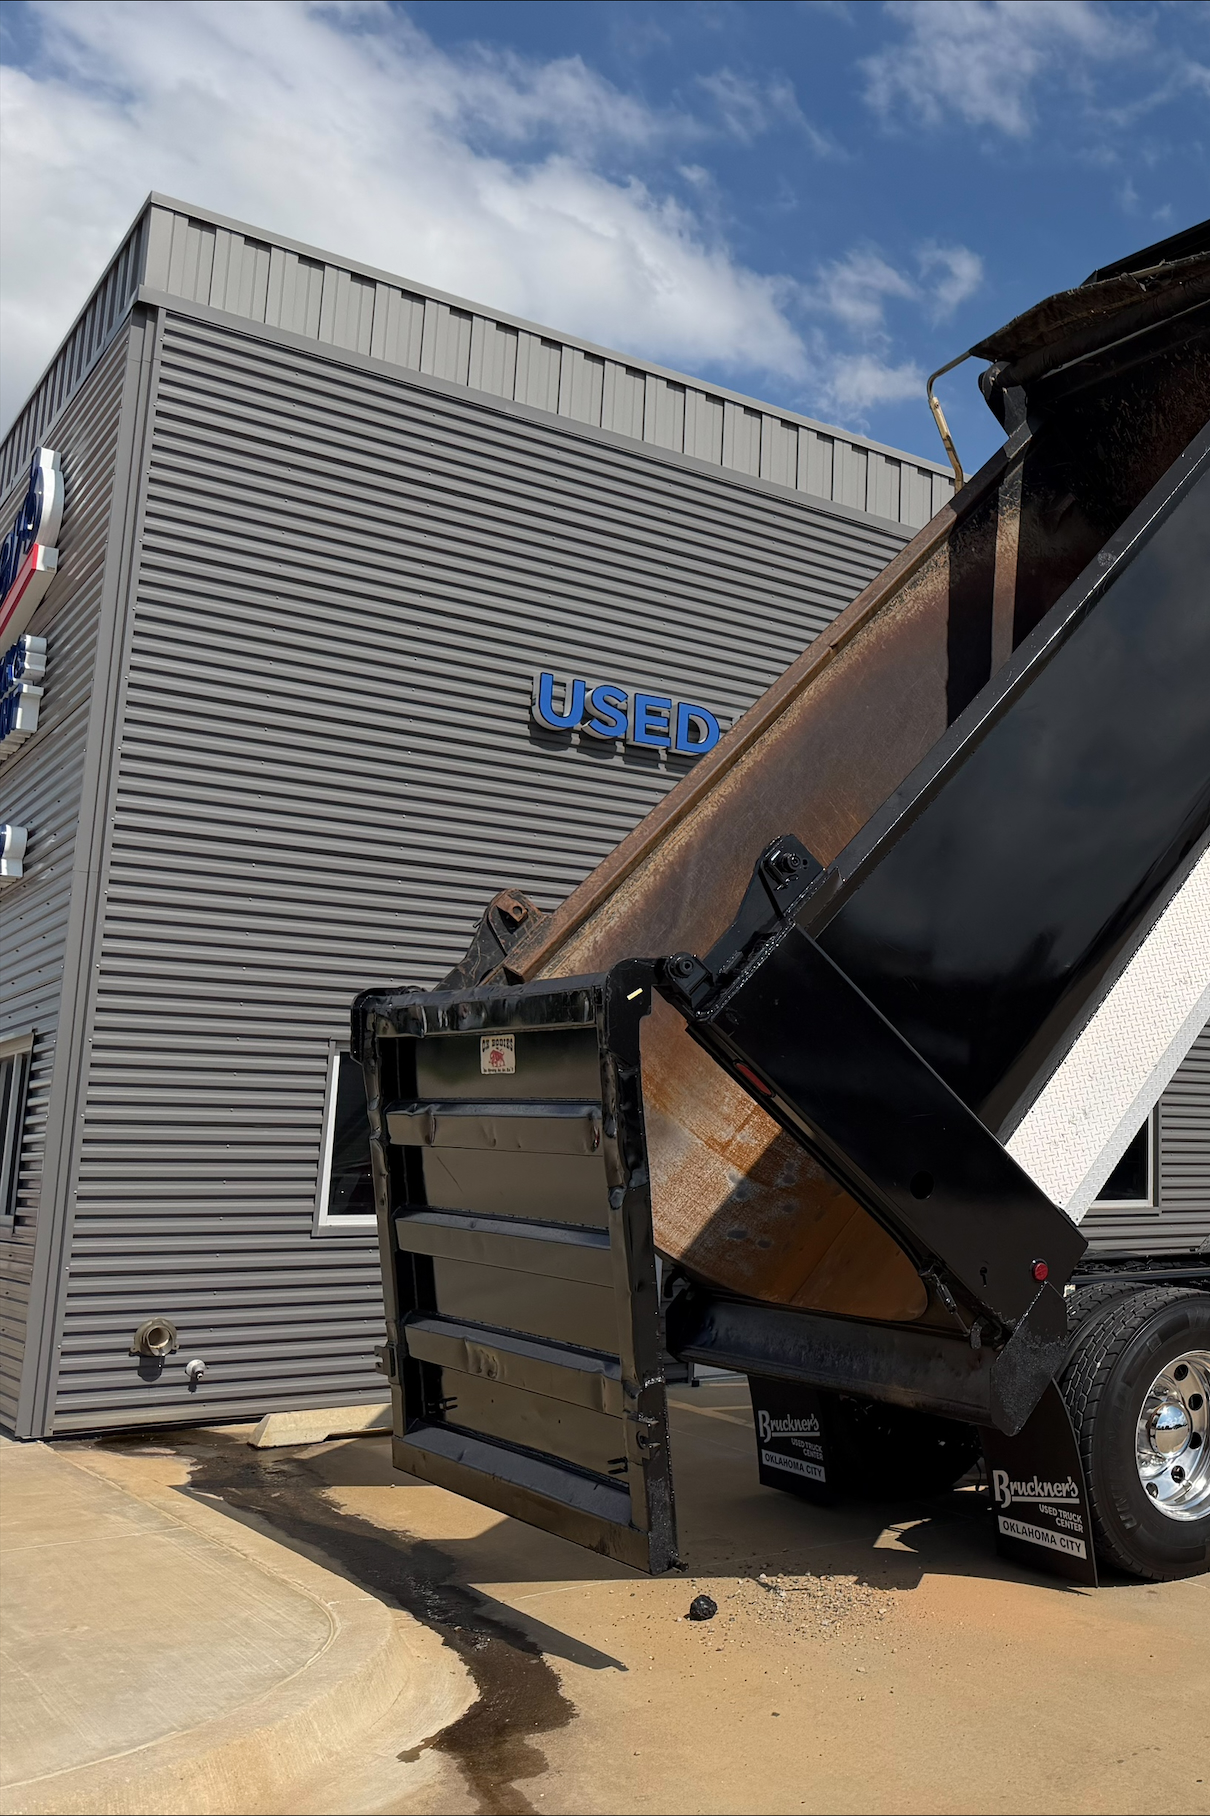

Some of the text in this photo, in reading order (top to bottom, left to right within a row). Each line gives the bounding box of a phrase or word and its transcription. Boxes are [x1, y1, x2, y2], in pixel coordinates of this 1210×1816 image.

[534, 672, 721, 755] USED
[758, 1410, 820, 1443] Bruckner's
[791, 1438, 823, 1453] USED TRUCK
[803, 1449, 824, 1460] CENTER
[765, 1453, 822, 1477] OKLAHOMA CITY
[993, 1470, 1079, 1508] Bruckner's
[1039, 1504, 1082, 1523] USED TRUCK
[1055, 1517, 1083, 1533] CENTER
[1002, 1521, 1081, 1552] OKLAHOMA CITY
